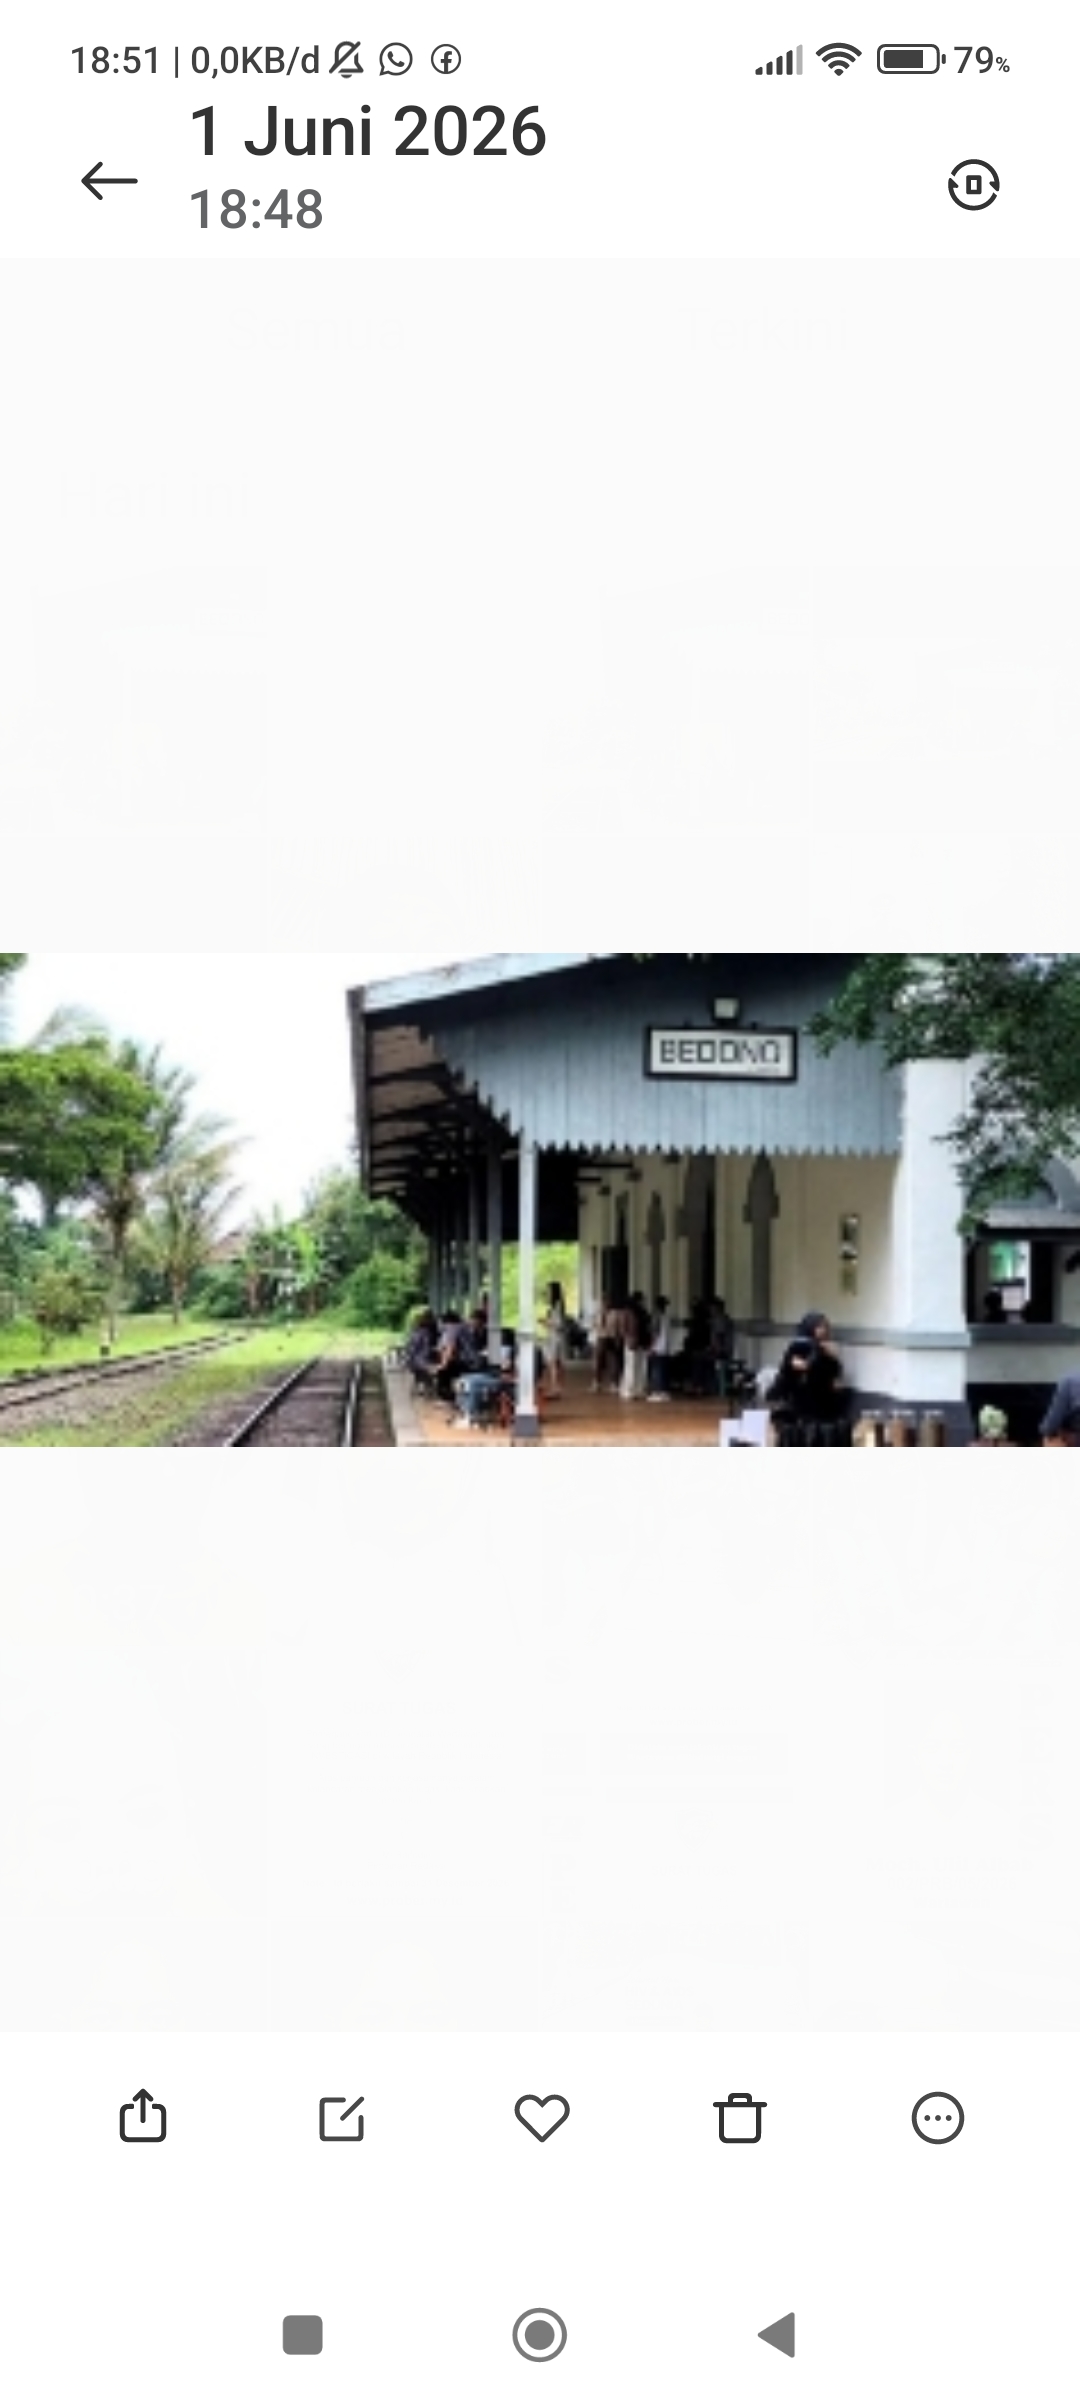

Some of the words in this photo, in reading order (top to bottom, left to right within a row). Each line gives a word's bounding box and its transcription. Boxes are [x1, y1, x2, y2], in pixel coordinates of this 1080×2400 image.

[72, 46, 157, 74] 18:51
[192, 45, 320, 80] 0,0KB/d
[953, 45, 1011, 74] 79%
[193, 105, 214, 156] 1
[244, 104, 372, 157] Juni
[395, 104, 546, 157] 2026
[190, 188, 323, 230] 18:48
